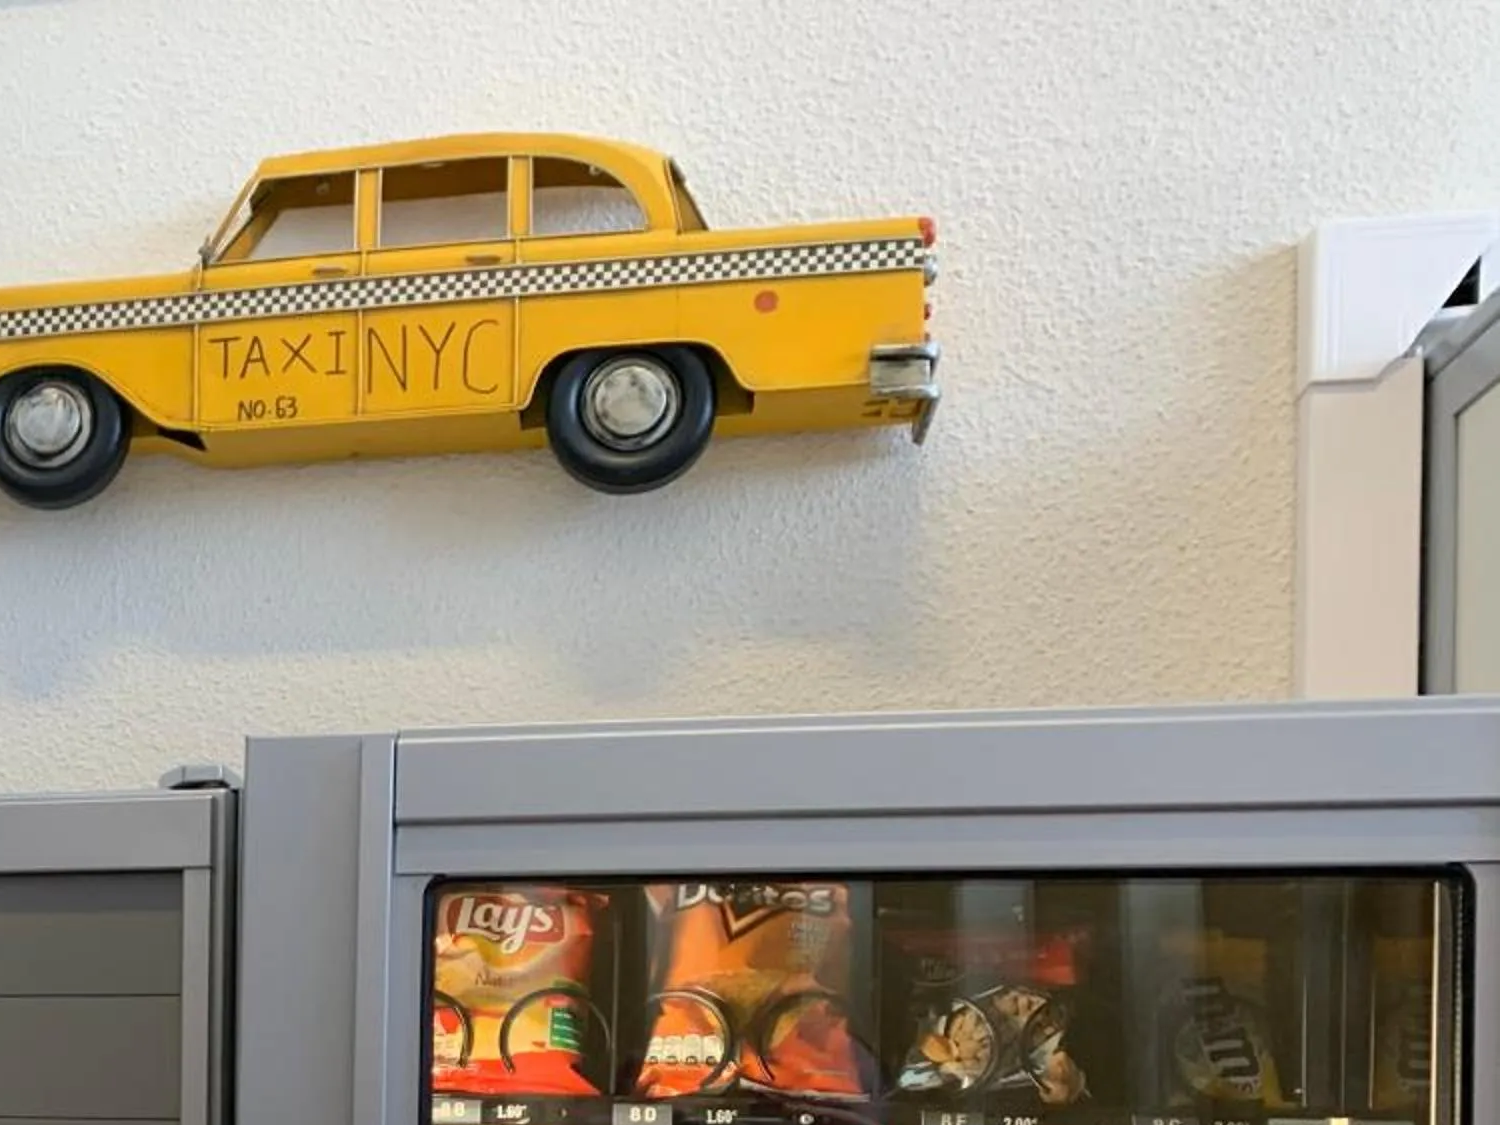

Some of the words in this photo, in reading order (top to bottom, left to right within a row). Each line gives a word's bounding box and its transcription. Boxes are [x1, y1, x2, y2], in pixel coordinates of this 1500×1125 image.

[207, 330, 348, 380] TAXI
[367, 318, 499, 395] NYC
[677, 884, 833, 913] Doitos
